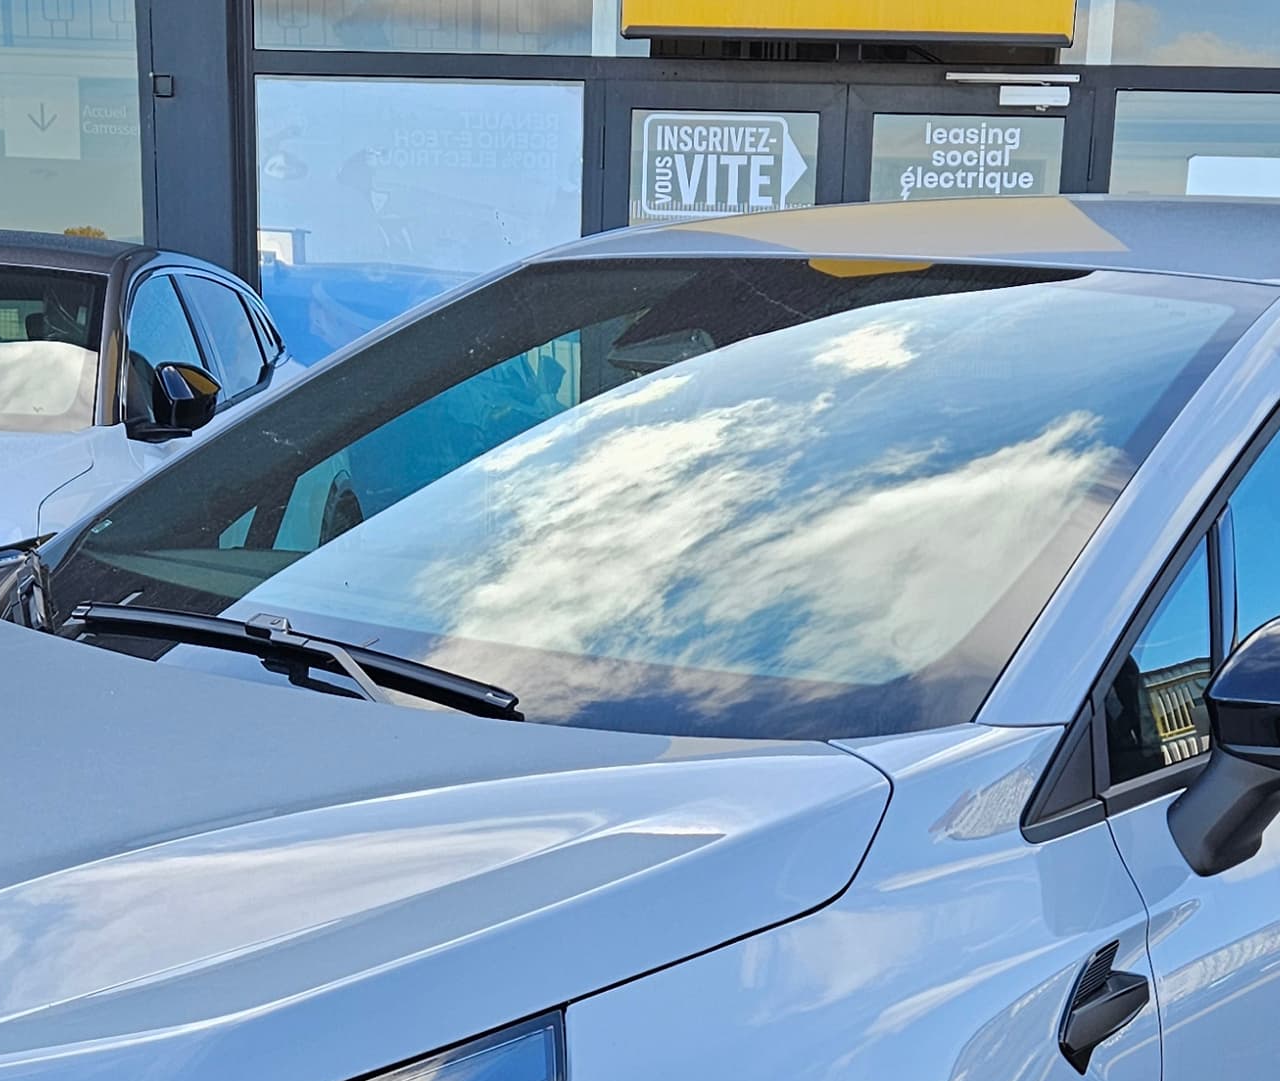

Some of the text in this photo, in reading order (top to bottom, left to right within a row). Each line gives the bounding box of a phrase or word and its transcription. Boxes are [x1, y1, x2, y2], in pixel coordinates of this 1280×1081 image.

[656, 125, 777, 153] INSCRIVEZ-
[925, 122, 1021, 149] leasing
[932, 144, 1013, 168] social
[655, 155, 673, 204] VOUS
[674, 155, 774, 206] VITE
[900, 166, 1034, 195] électrique
